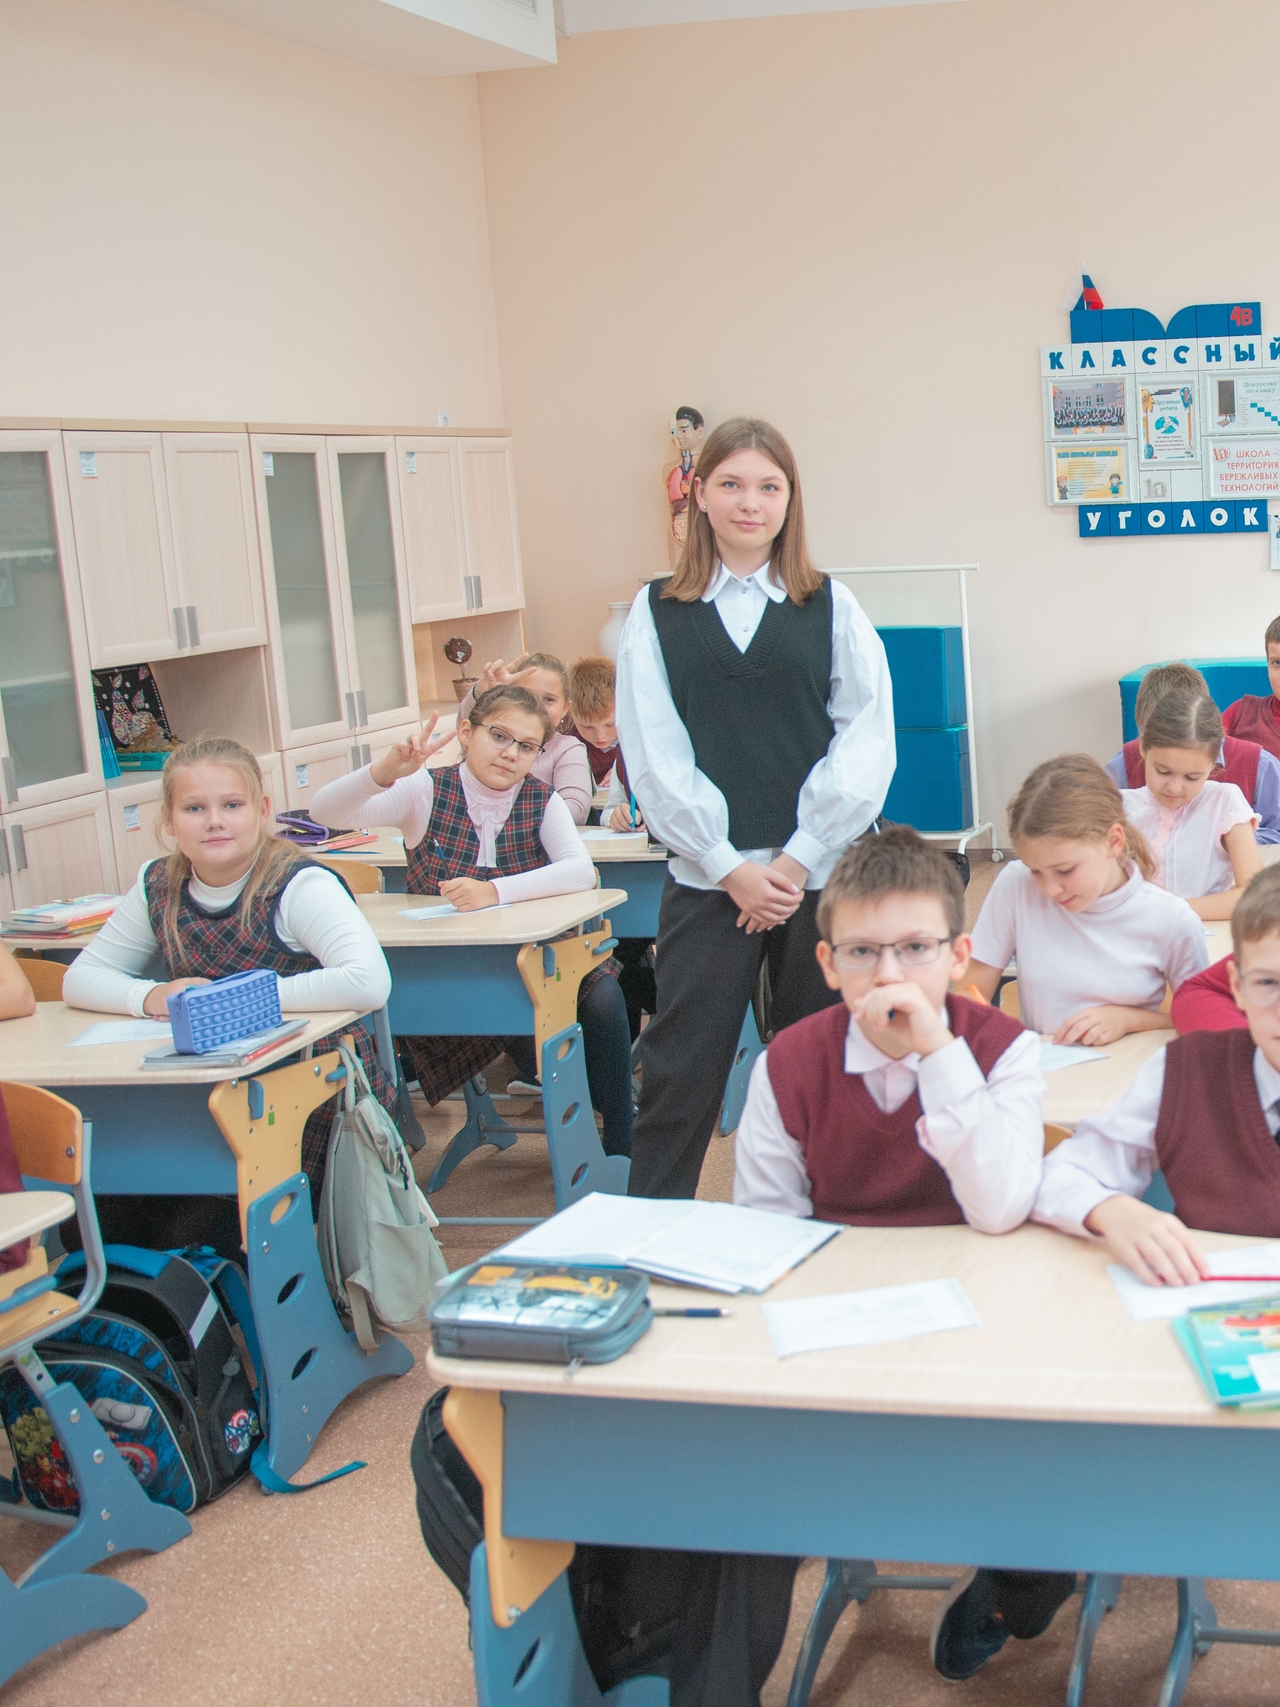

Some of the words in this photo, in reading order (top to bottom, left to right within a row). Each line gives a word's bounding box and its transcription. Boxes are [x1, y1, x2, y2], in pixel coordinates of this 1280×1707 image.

[1236, 450, 1271, 458] ШКОЛА
[1227, 461, 1279, 470] ТЕРРИТОРИЯ
[1219, 472, 1279, 481] БЕРЕЖЛИВЫХ
[1220, 482, 1279, 492] ТЕХНОЛОГИЙ
[1086, 507, 1260, 531] УГОЛОК
